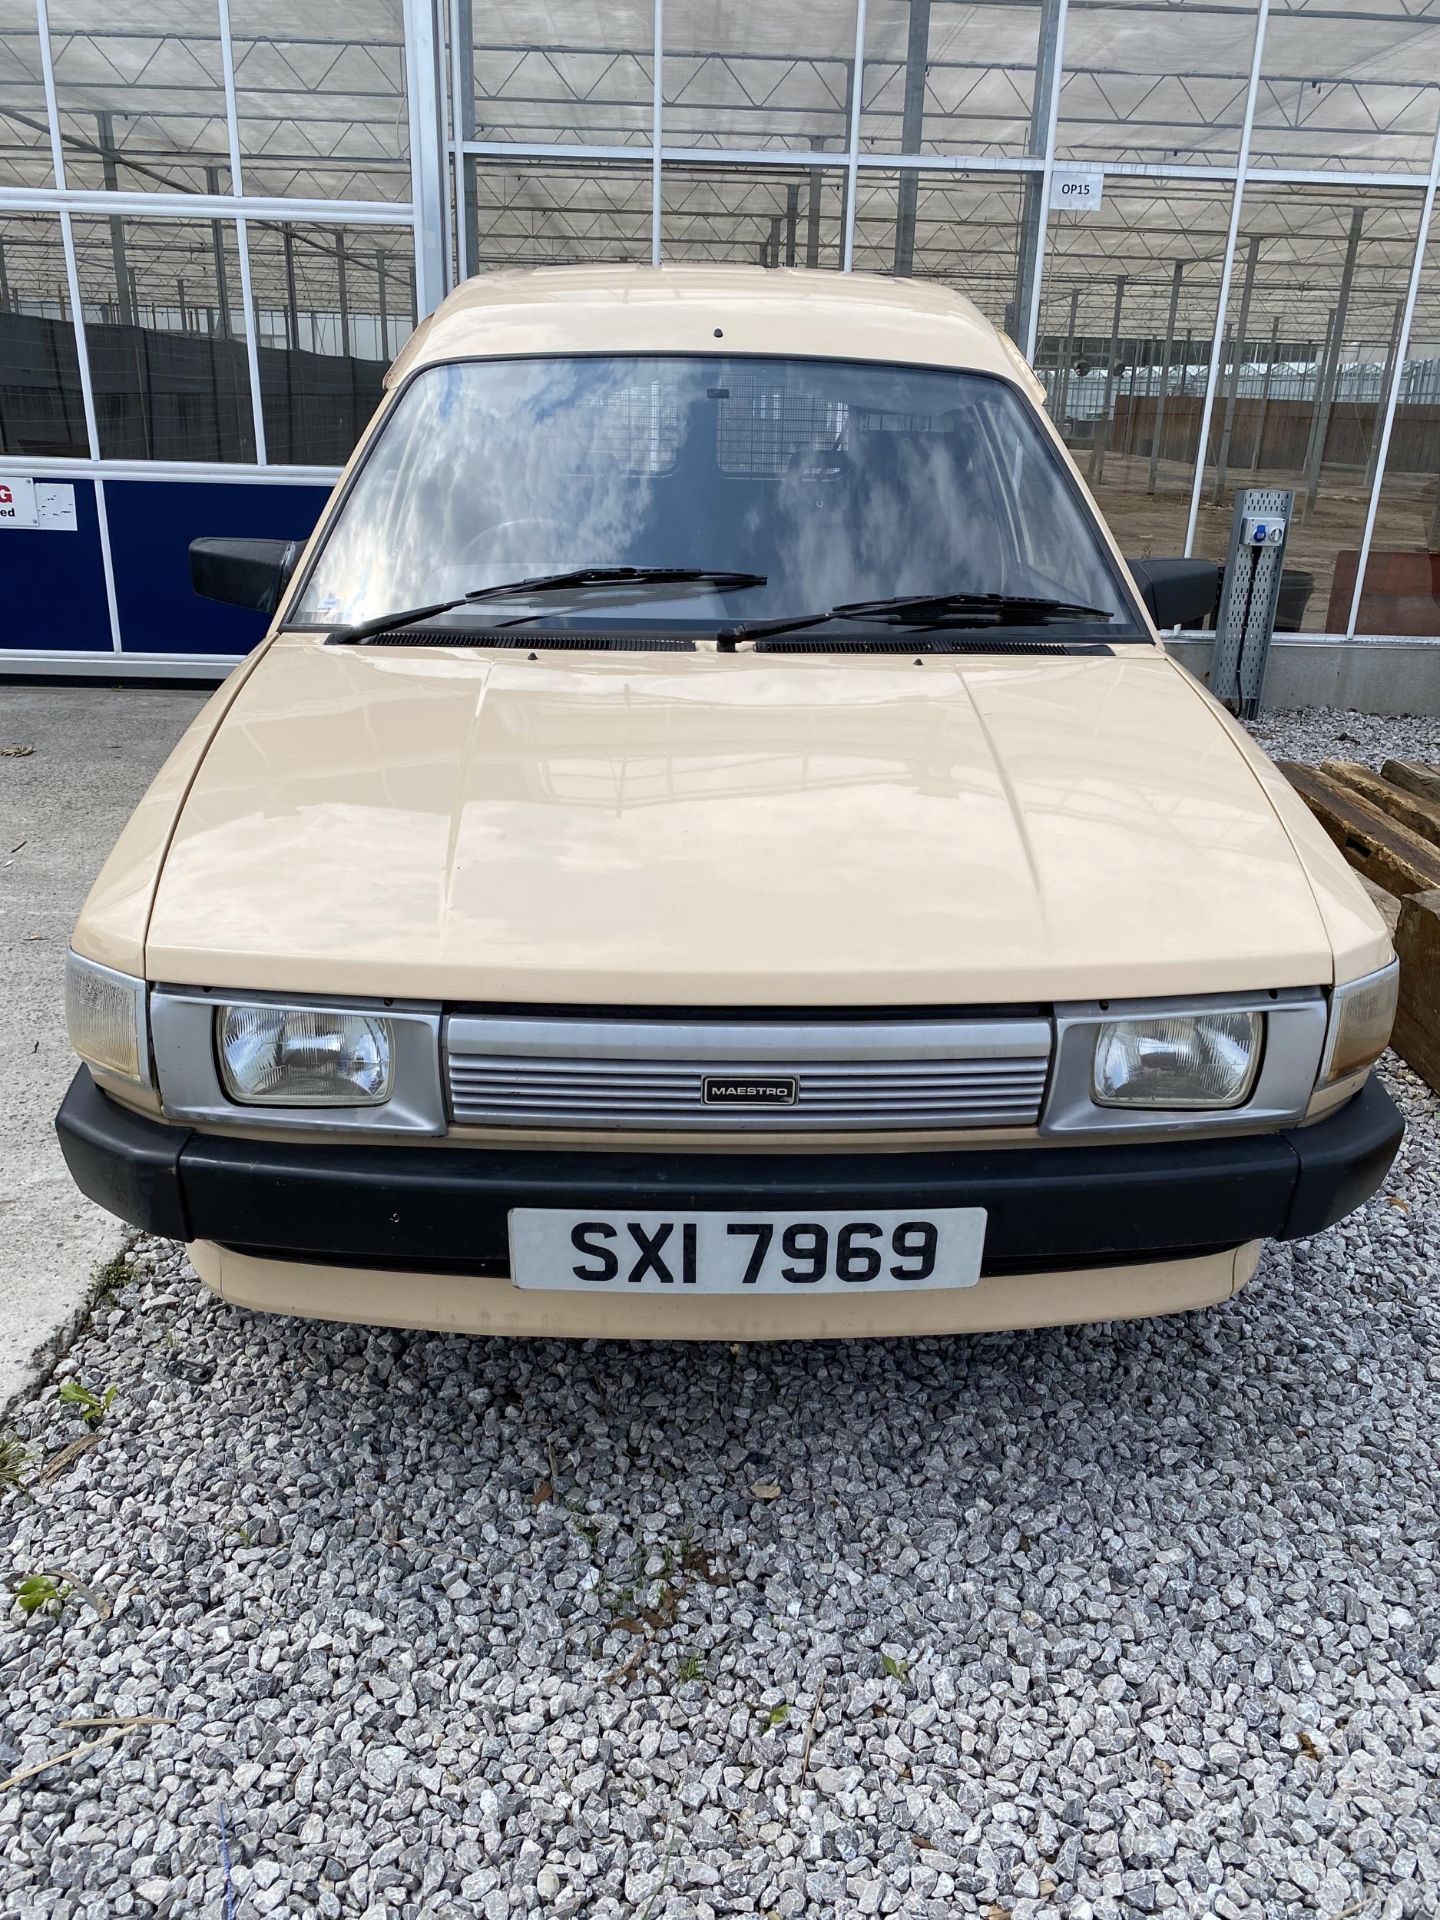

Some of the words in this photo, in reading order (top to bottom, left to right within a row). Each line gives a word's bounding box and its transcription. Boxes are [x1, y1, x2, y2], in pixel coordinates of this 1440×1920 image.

[1061, 183, 1090, 195] OP15
[711, 1087, 788, 1096] MAESTRO
[571, 1222, 697, 1284] SXI
[726, 1221, 939, 1284] 7969
